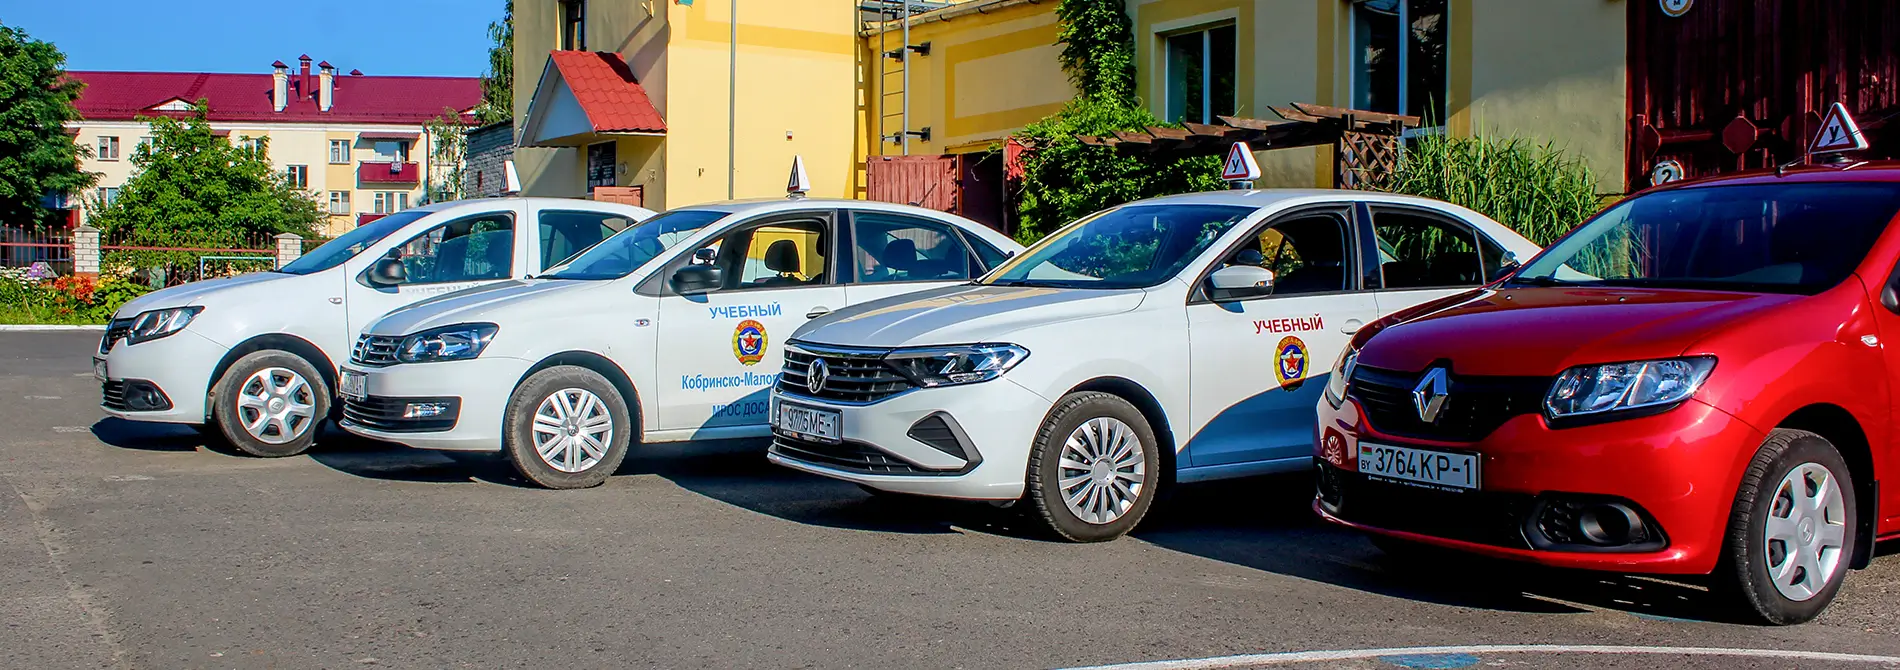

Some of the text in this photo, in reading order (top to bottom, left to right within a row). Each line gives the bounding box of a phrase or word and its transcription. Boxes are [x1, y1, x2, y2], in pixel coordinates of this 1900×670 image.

[1829, 125, 1840, 144] У
[1232, 159, 1240, 173] У
[709, 301, 782, 319] УЧЕБНЫЙ
[1253, 313, 1324, 335] УЧЕБНЫЙ
[712, 403, 741, 418] МРОС
[1360, 459, 1371, 470] BY
